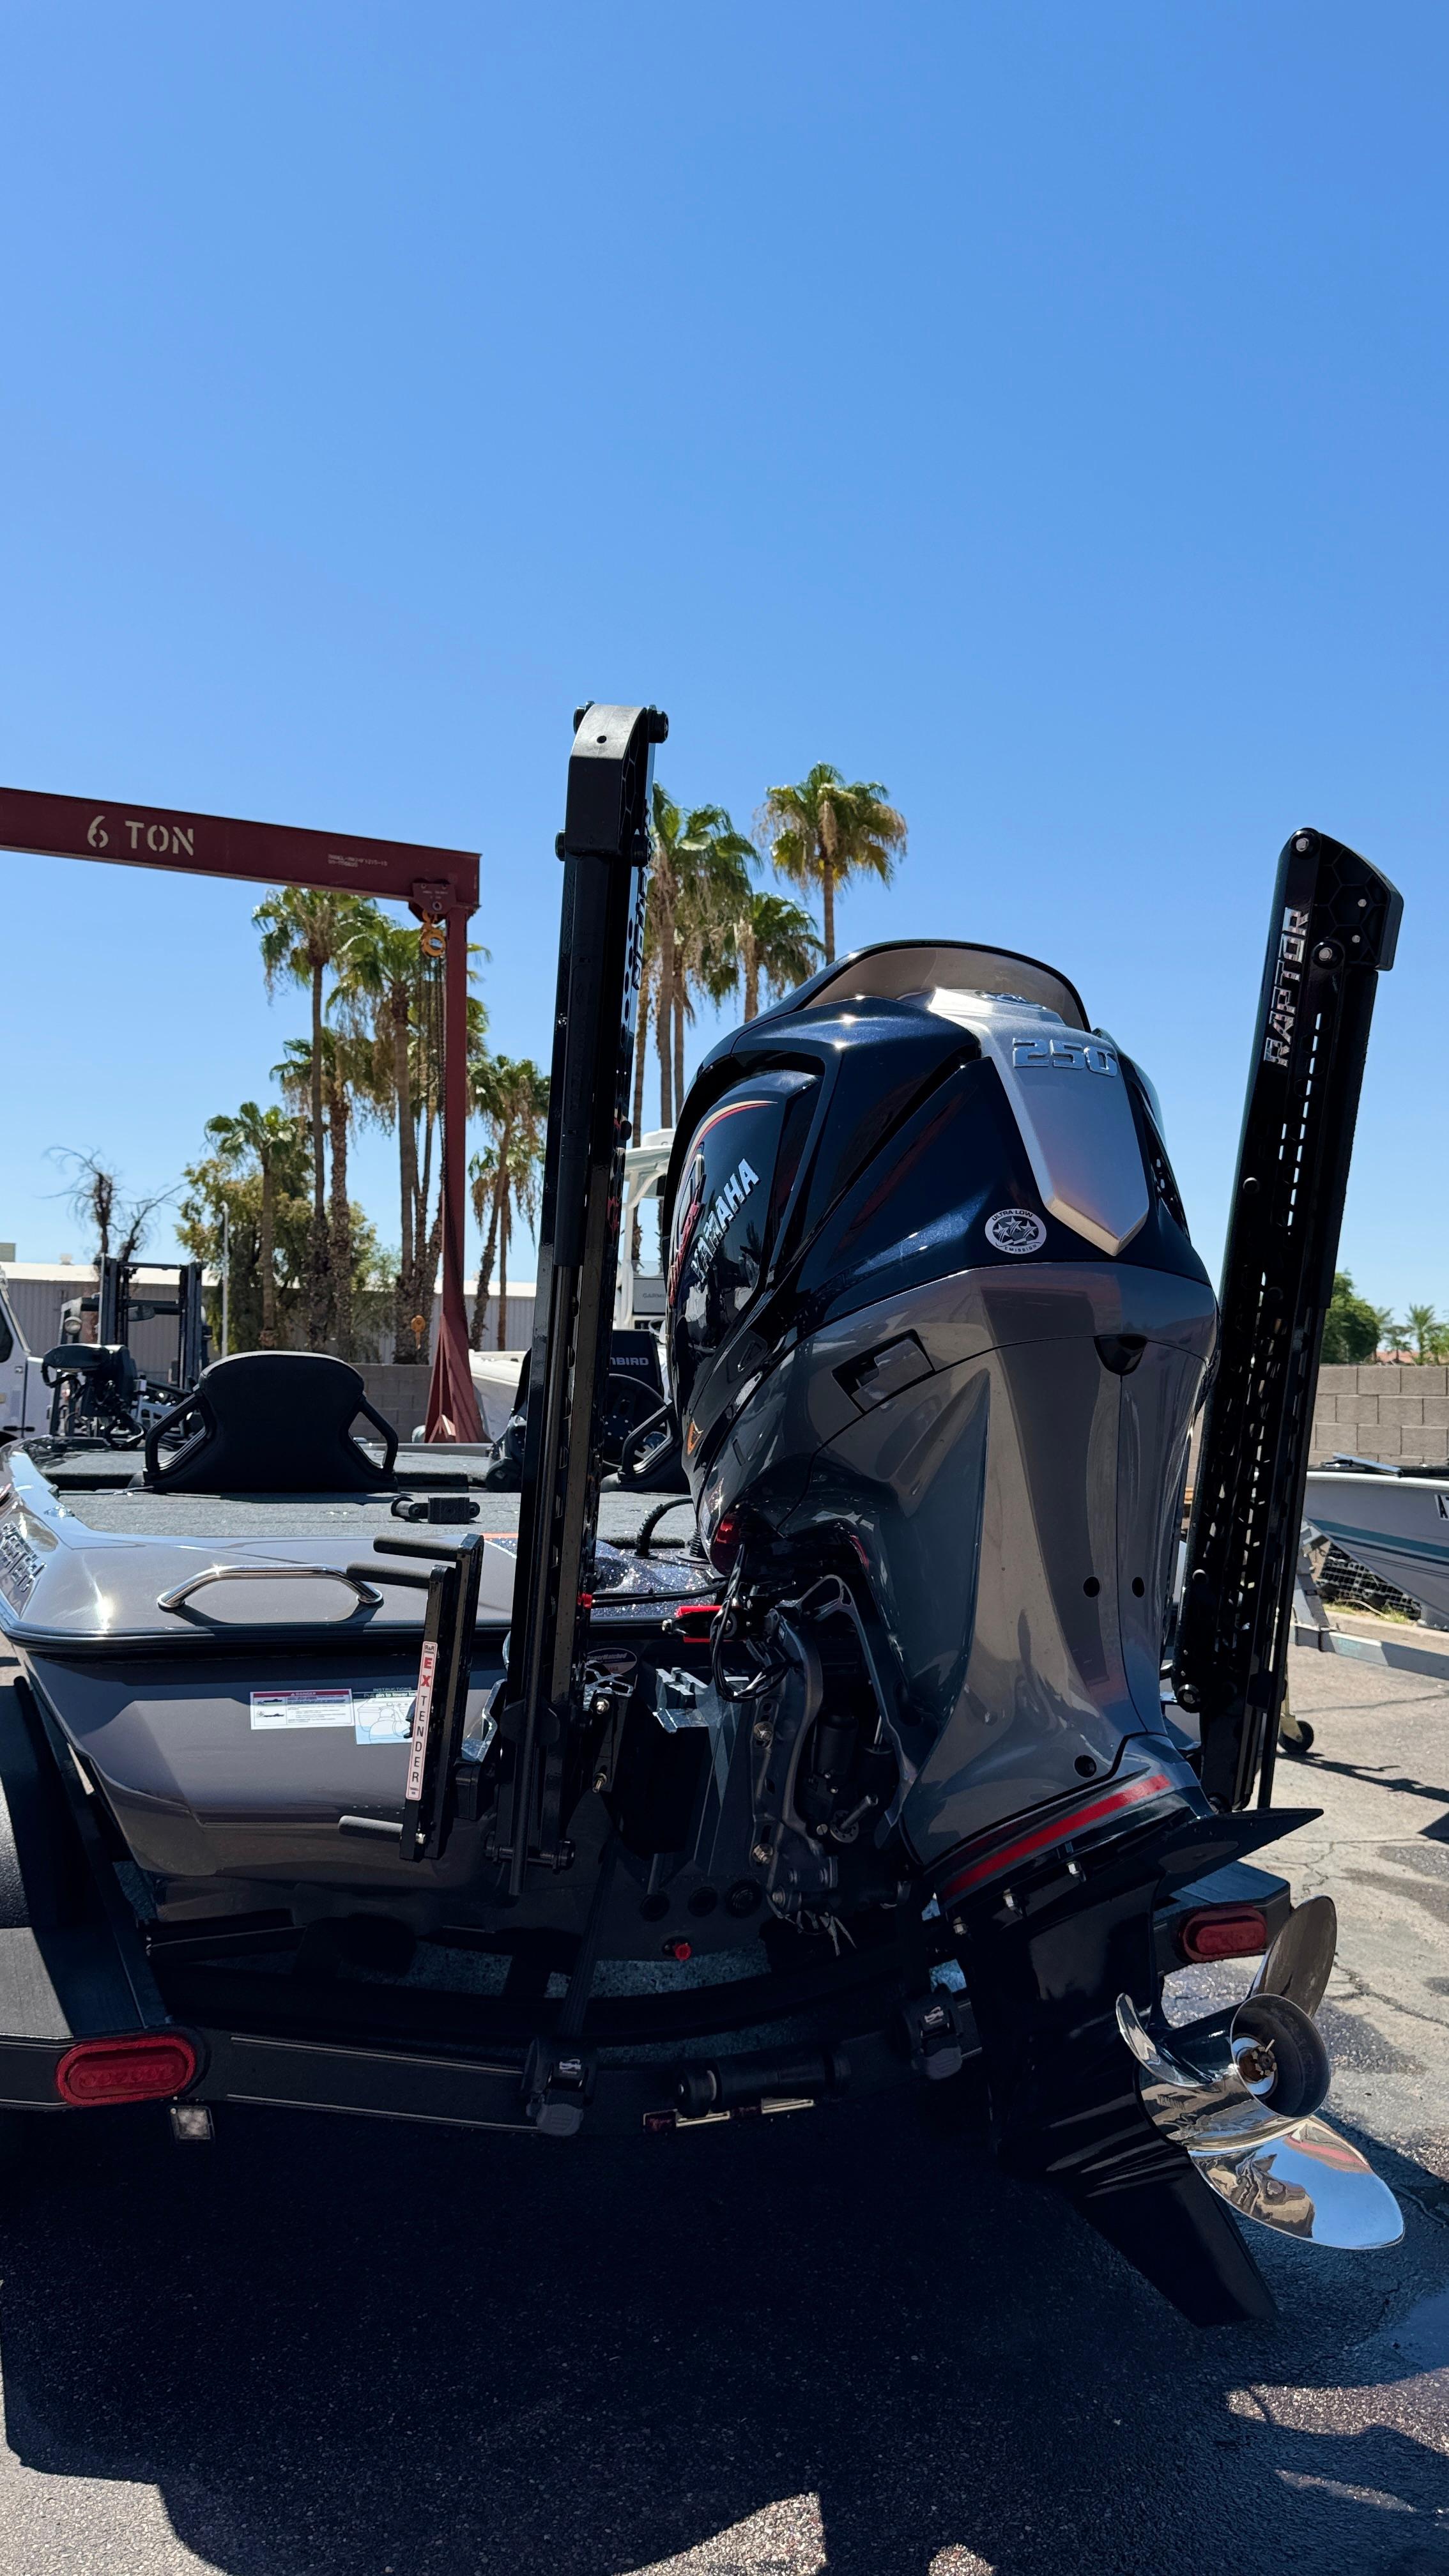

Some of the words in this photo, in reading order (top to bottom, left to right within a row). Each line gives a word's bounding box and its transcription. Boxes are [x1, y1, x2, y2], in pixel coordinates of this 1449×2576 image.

[87, 815, 109, 848] 6
[125, 820, 194, 856] TON
[1264, 907, 1309, 1068] RAPTOR
[1012, 1037, 1118, 1078] 250
[691, 1158, 760, 1284] YAMAHA
[992, 1210, 1013, 1221] ULTRA
[1004, 1244, 1038, 1252] EMISSION
[1438, 1495, 1449, 1519] A
